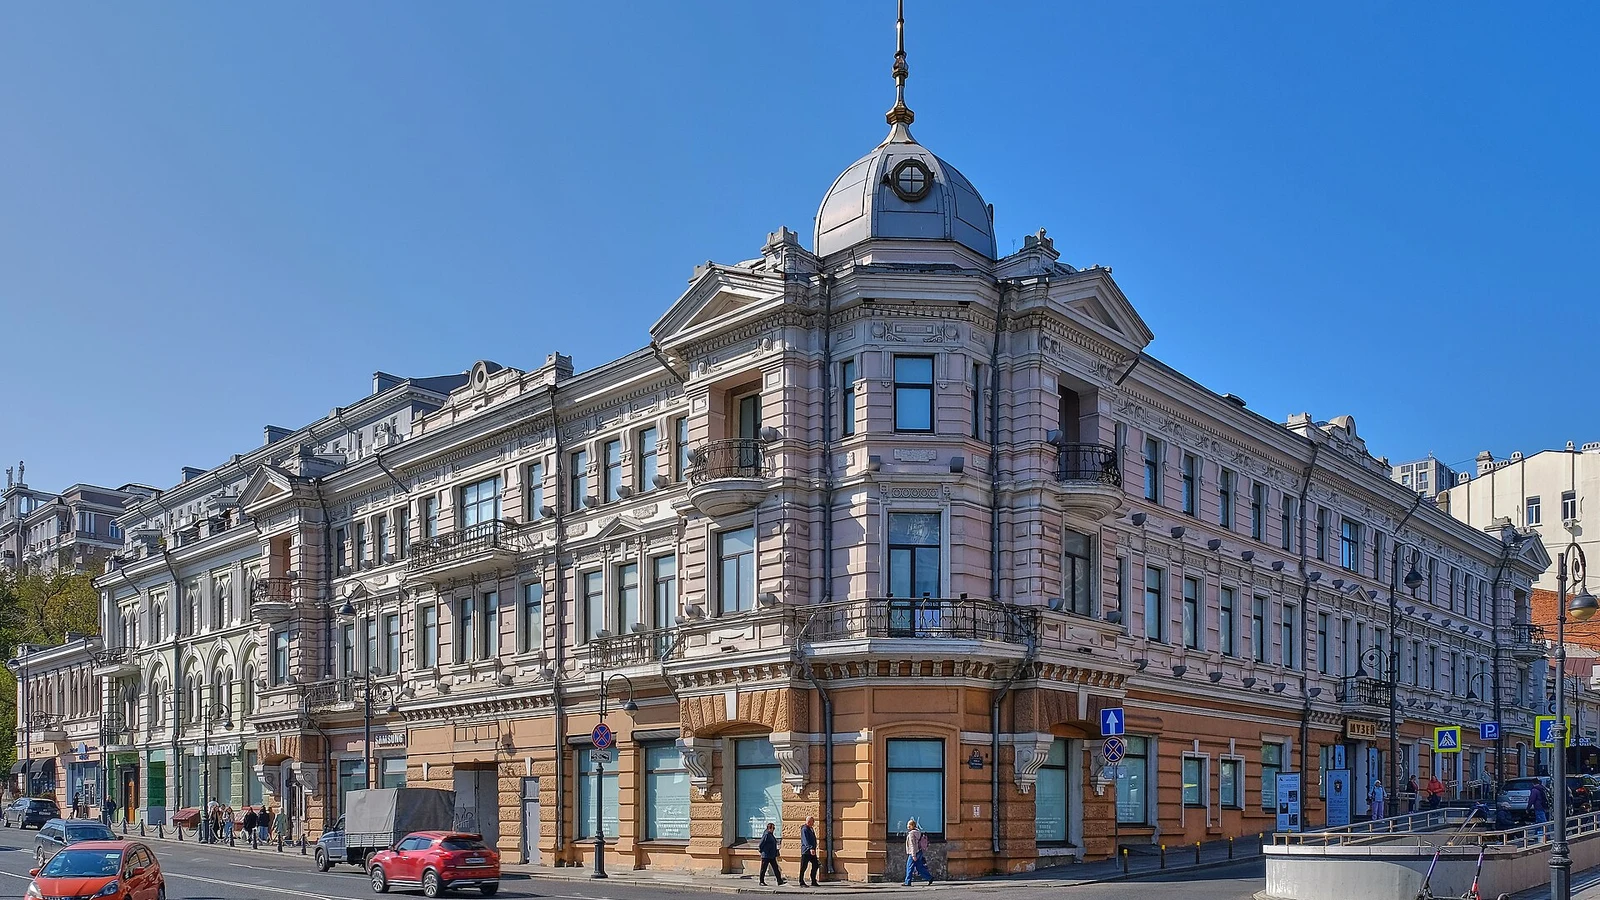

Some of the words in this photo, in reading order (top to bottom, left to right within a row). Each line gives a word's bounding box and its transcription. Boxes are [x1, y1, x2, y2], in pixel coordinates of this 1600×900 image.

[1350, 723, 1375, 735] МУЗЕЙ
[1485, 724, 1496, 738] P
[375, 733, 404, 744] SAMSUNG
